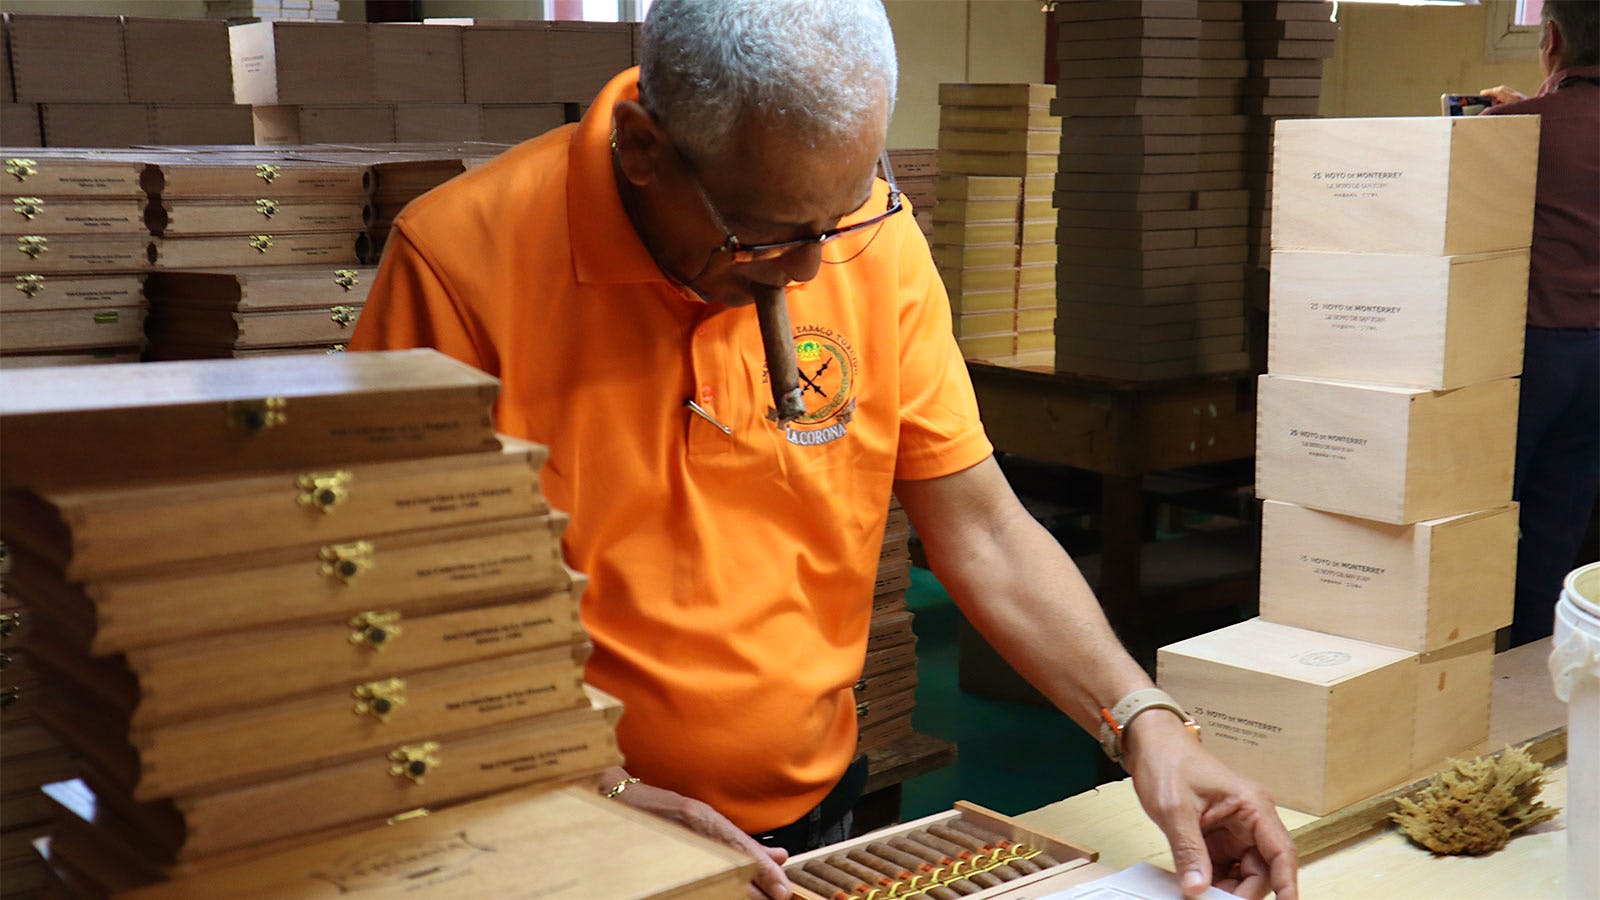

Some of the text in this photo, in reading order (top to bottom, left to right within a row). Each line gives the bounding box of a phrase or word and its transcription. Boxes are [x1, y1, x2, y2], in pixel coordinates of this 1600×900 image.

[1322, 303, 1343, 311] HOYO
[1354, 304, 1401, 313] MONTERREY
[795, 325, 833, 336] TABACO
[785, 422, 847, 445] LA CORONA
[1300, 431, 1318, 439] HOYO
[1328, 434, 1368, 446] MONTERREY
[1310, 557, 1331, 566] HOYO
[1341, 562, 1385, 574] MONTERREY
[1195, 706, 1204, 715] 25
[1206, 710, 1227, 721] HOYO
[1237, 717, 1283, 733] MONTERREY
